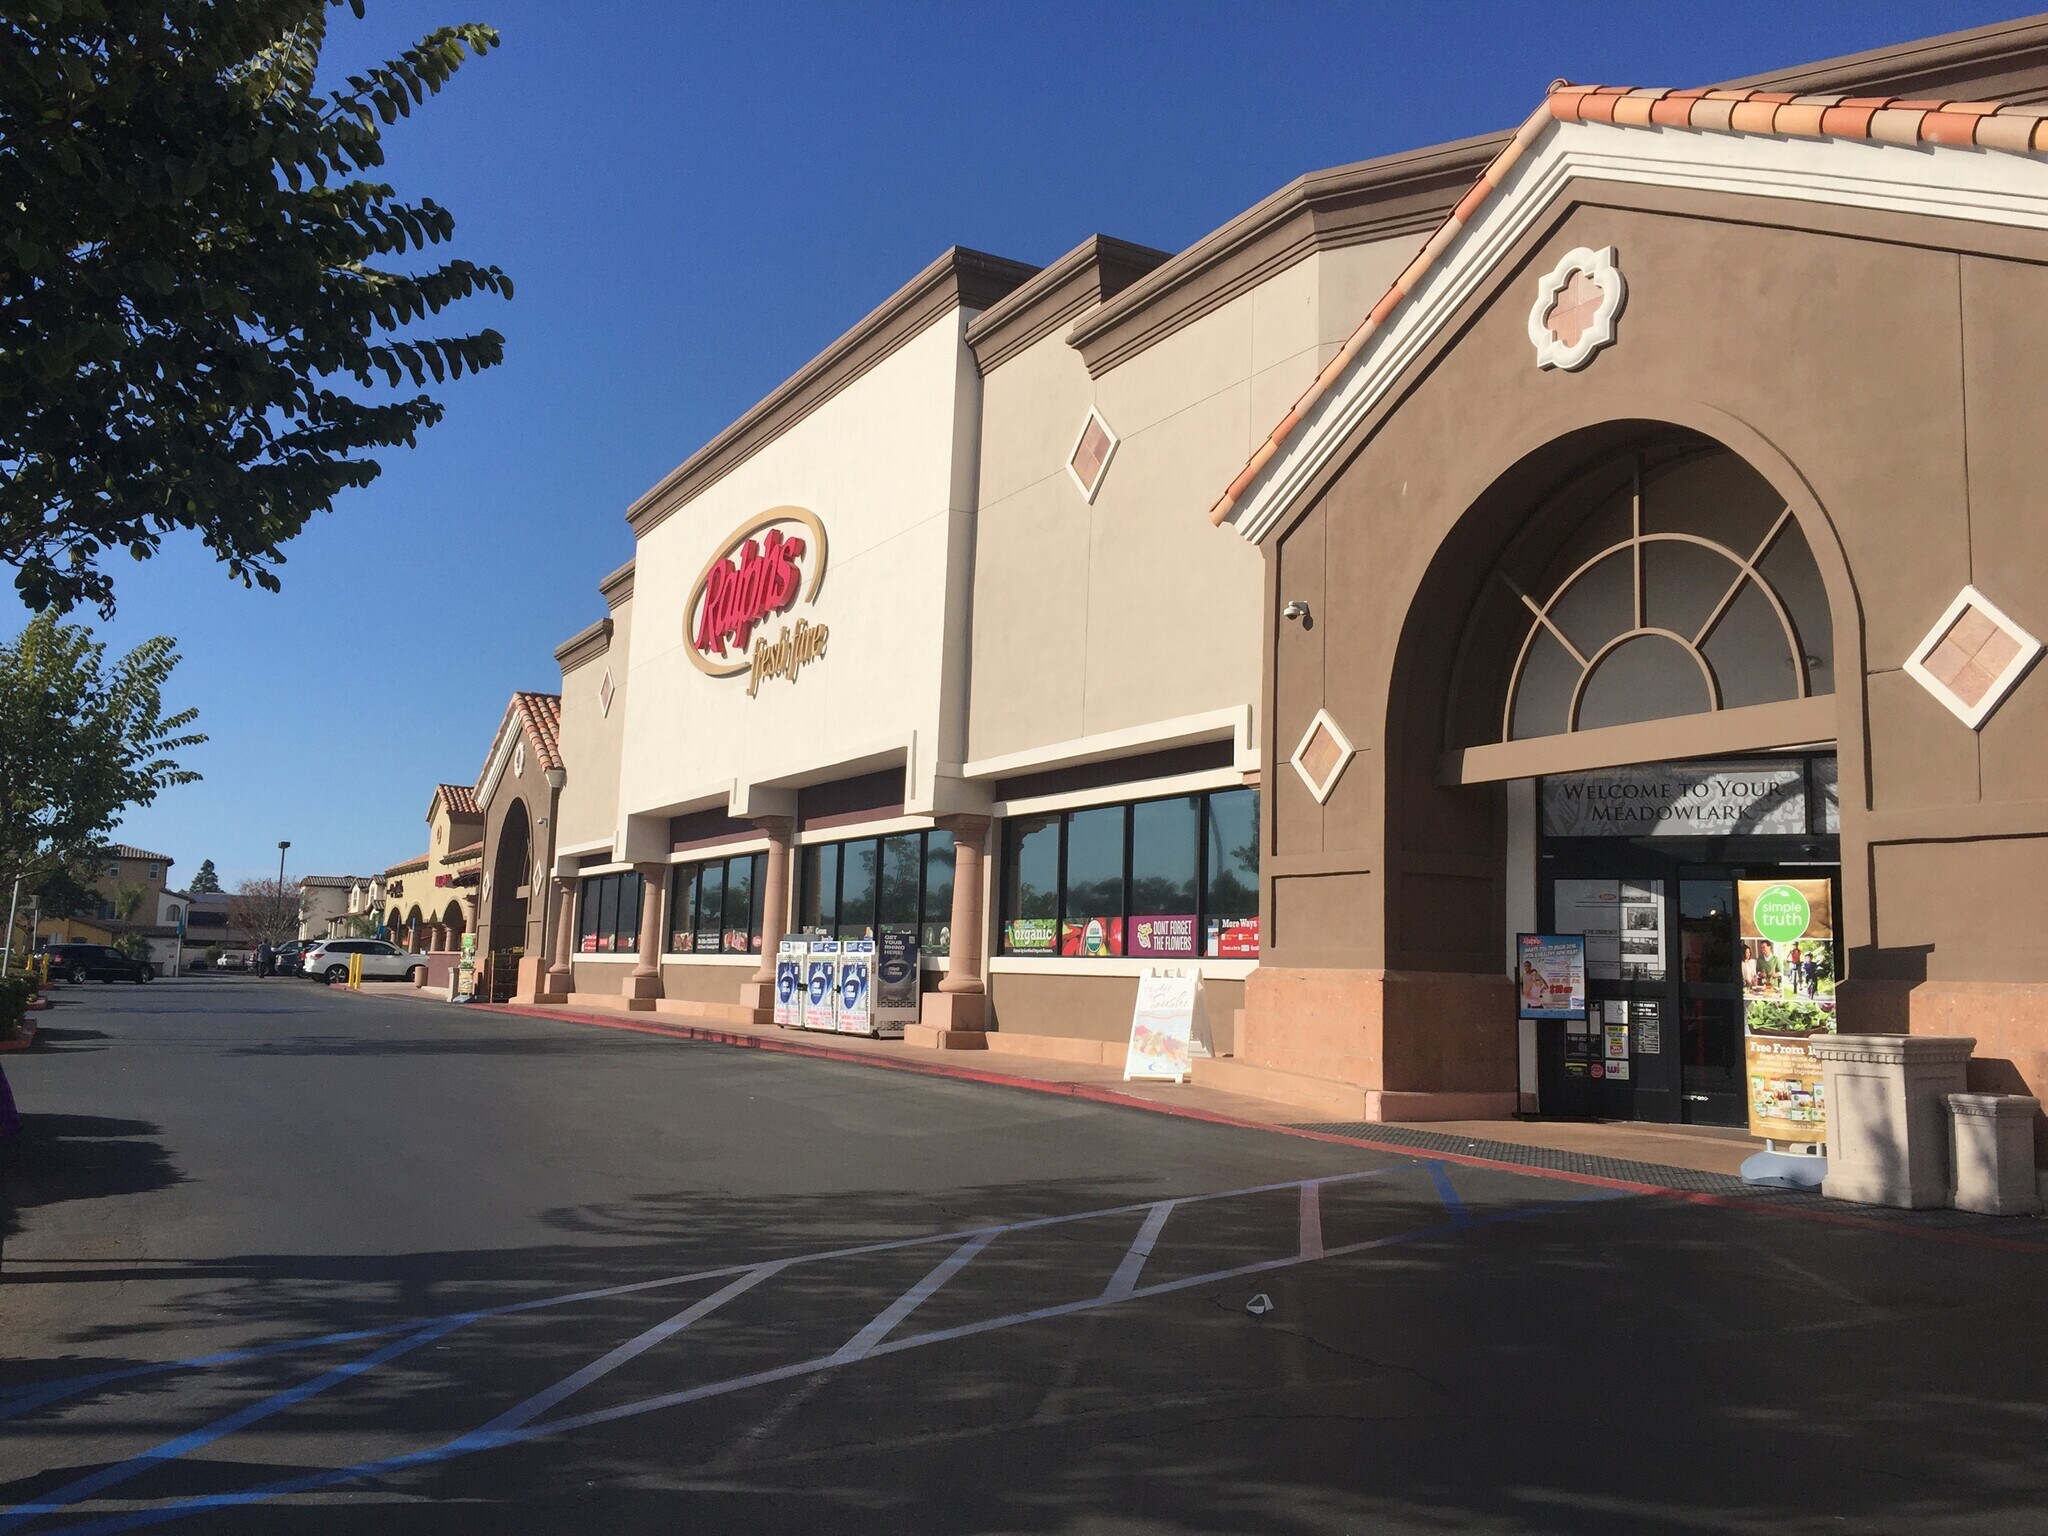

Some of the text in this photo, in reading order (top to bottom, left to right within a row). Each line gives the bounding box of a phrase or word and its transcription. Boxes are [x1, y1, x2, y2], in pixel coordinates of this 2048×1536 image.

[694, 528, 806, 653] Ralphs
[746, 618, 828, 696] fresh fare
[1563, 780, 1785, 799] WELCOME TO YOUR
[1592, 805, 1752, 821] MEADOWLARK
[1762, 901, 1802, 913] simple
[1222, 918, 1257, 930] More Ways
[1762, 912, 1802, 926] truth
[1014, 925, 1053, 945] organic
[1170, 920, 1192, 935] FORGET
[1153, 936, 1192, 950] THE FLOWERS
[1151, 991, 1189, 1009] Sushi
[1750, 1042, 1771, 1053] Free
[1773, 1044, 1805, 1055] From
